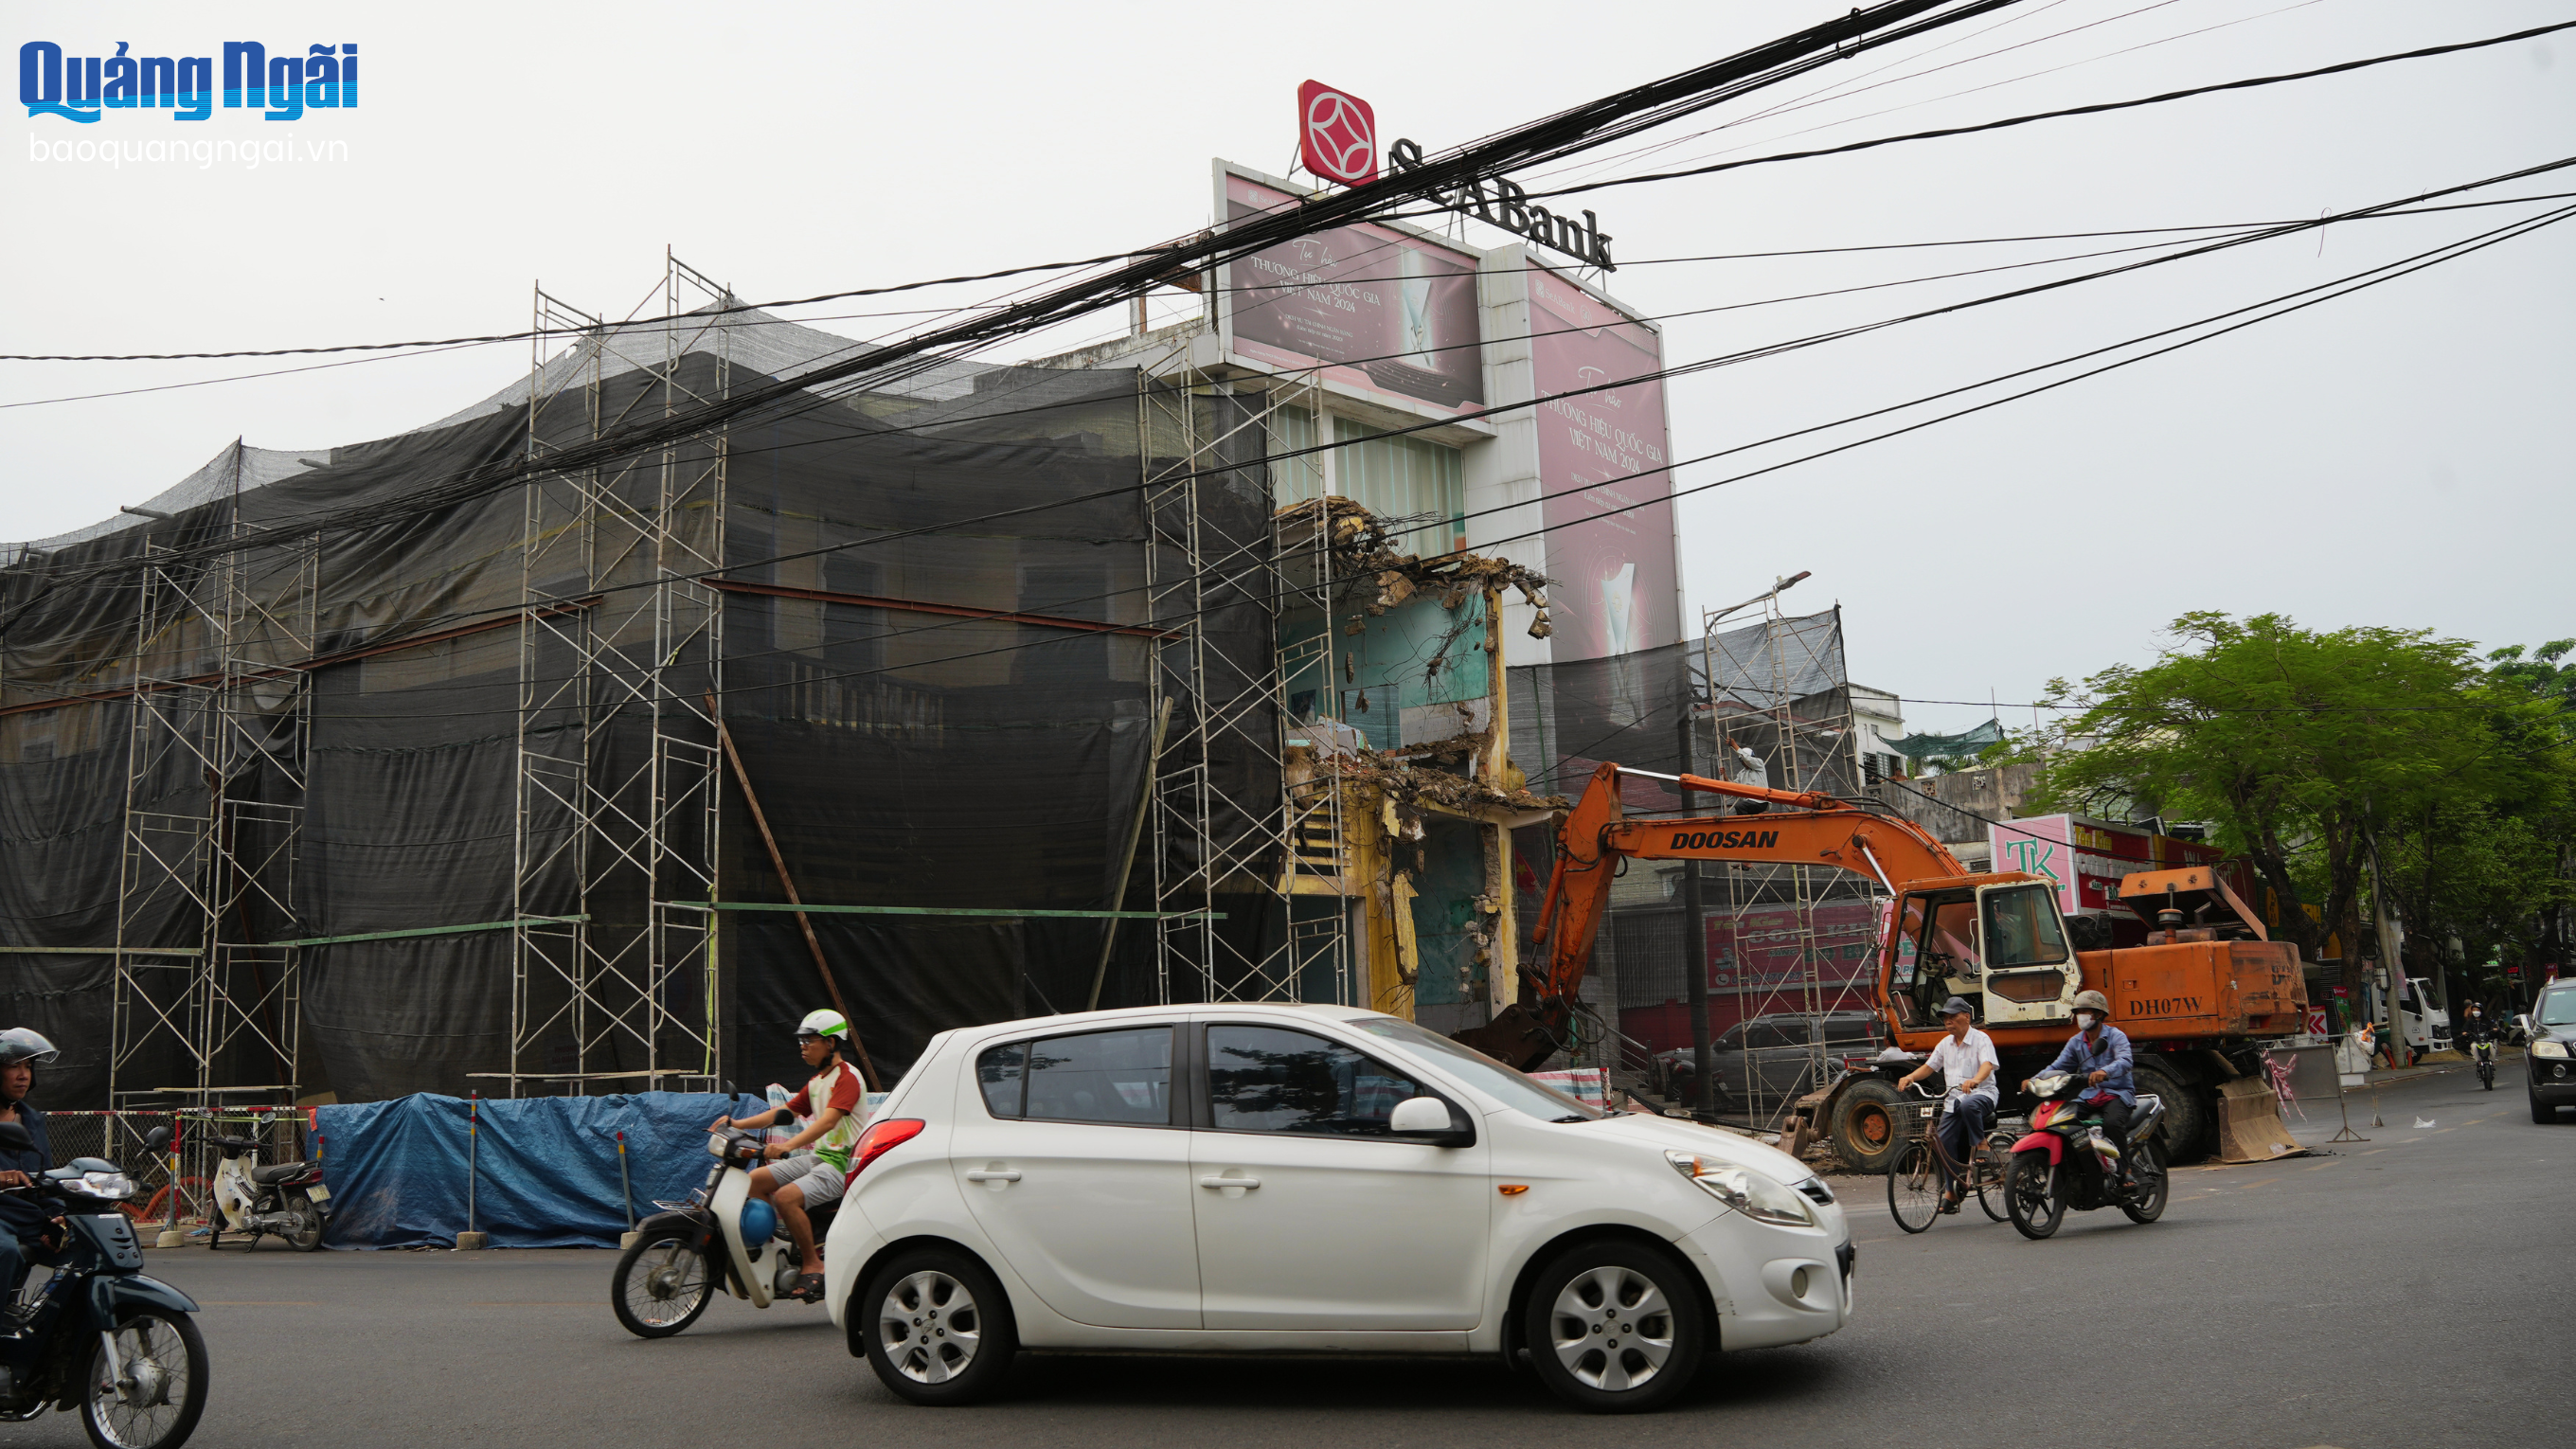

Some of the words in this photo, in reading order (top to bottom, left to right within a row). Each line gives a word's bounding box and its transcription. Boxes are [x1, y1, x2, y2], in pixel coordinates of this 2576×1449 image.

[1250, 256, 1299, 281] THƯƠNG
[1363, 291, 1382, 306] GIA
[1307, 288, 1331, 306] NAM
[1333, 296, 1356, 313] 2024
[1545, 288, 1576, 314] SeABank
[1568, 426, 1592, 451] VIỆT
[1595, 439, 1618, 464] NAM
[1619, 453, 1641, 474] 2024
[1589, 415, 1612, 439] HIỆU
[1615, 428, 1644, 455] QUỐC
[1646, 444, 1664, 464] GIA
[1670, 831, 1780, 850] DOOSAN
[2005, 838, 2060, 881] TK
[2130, 996, 2203, 1016] DH07W
